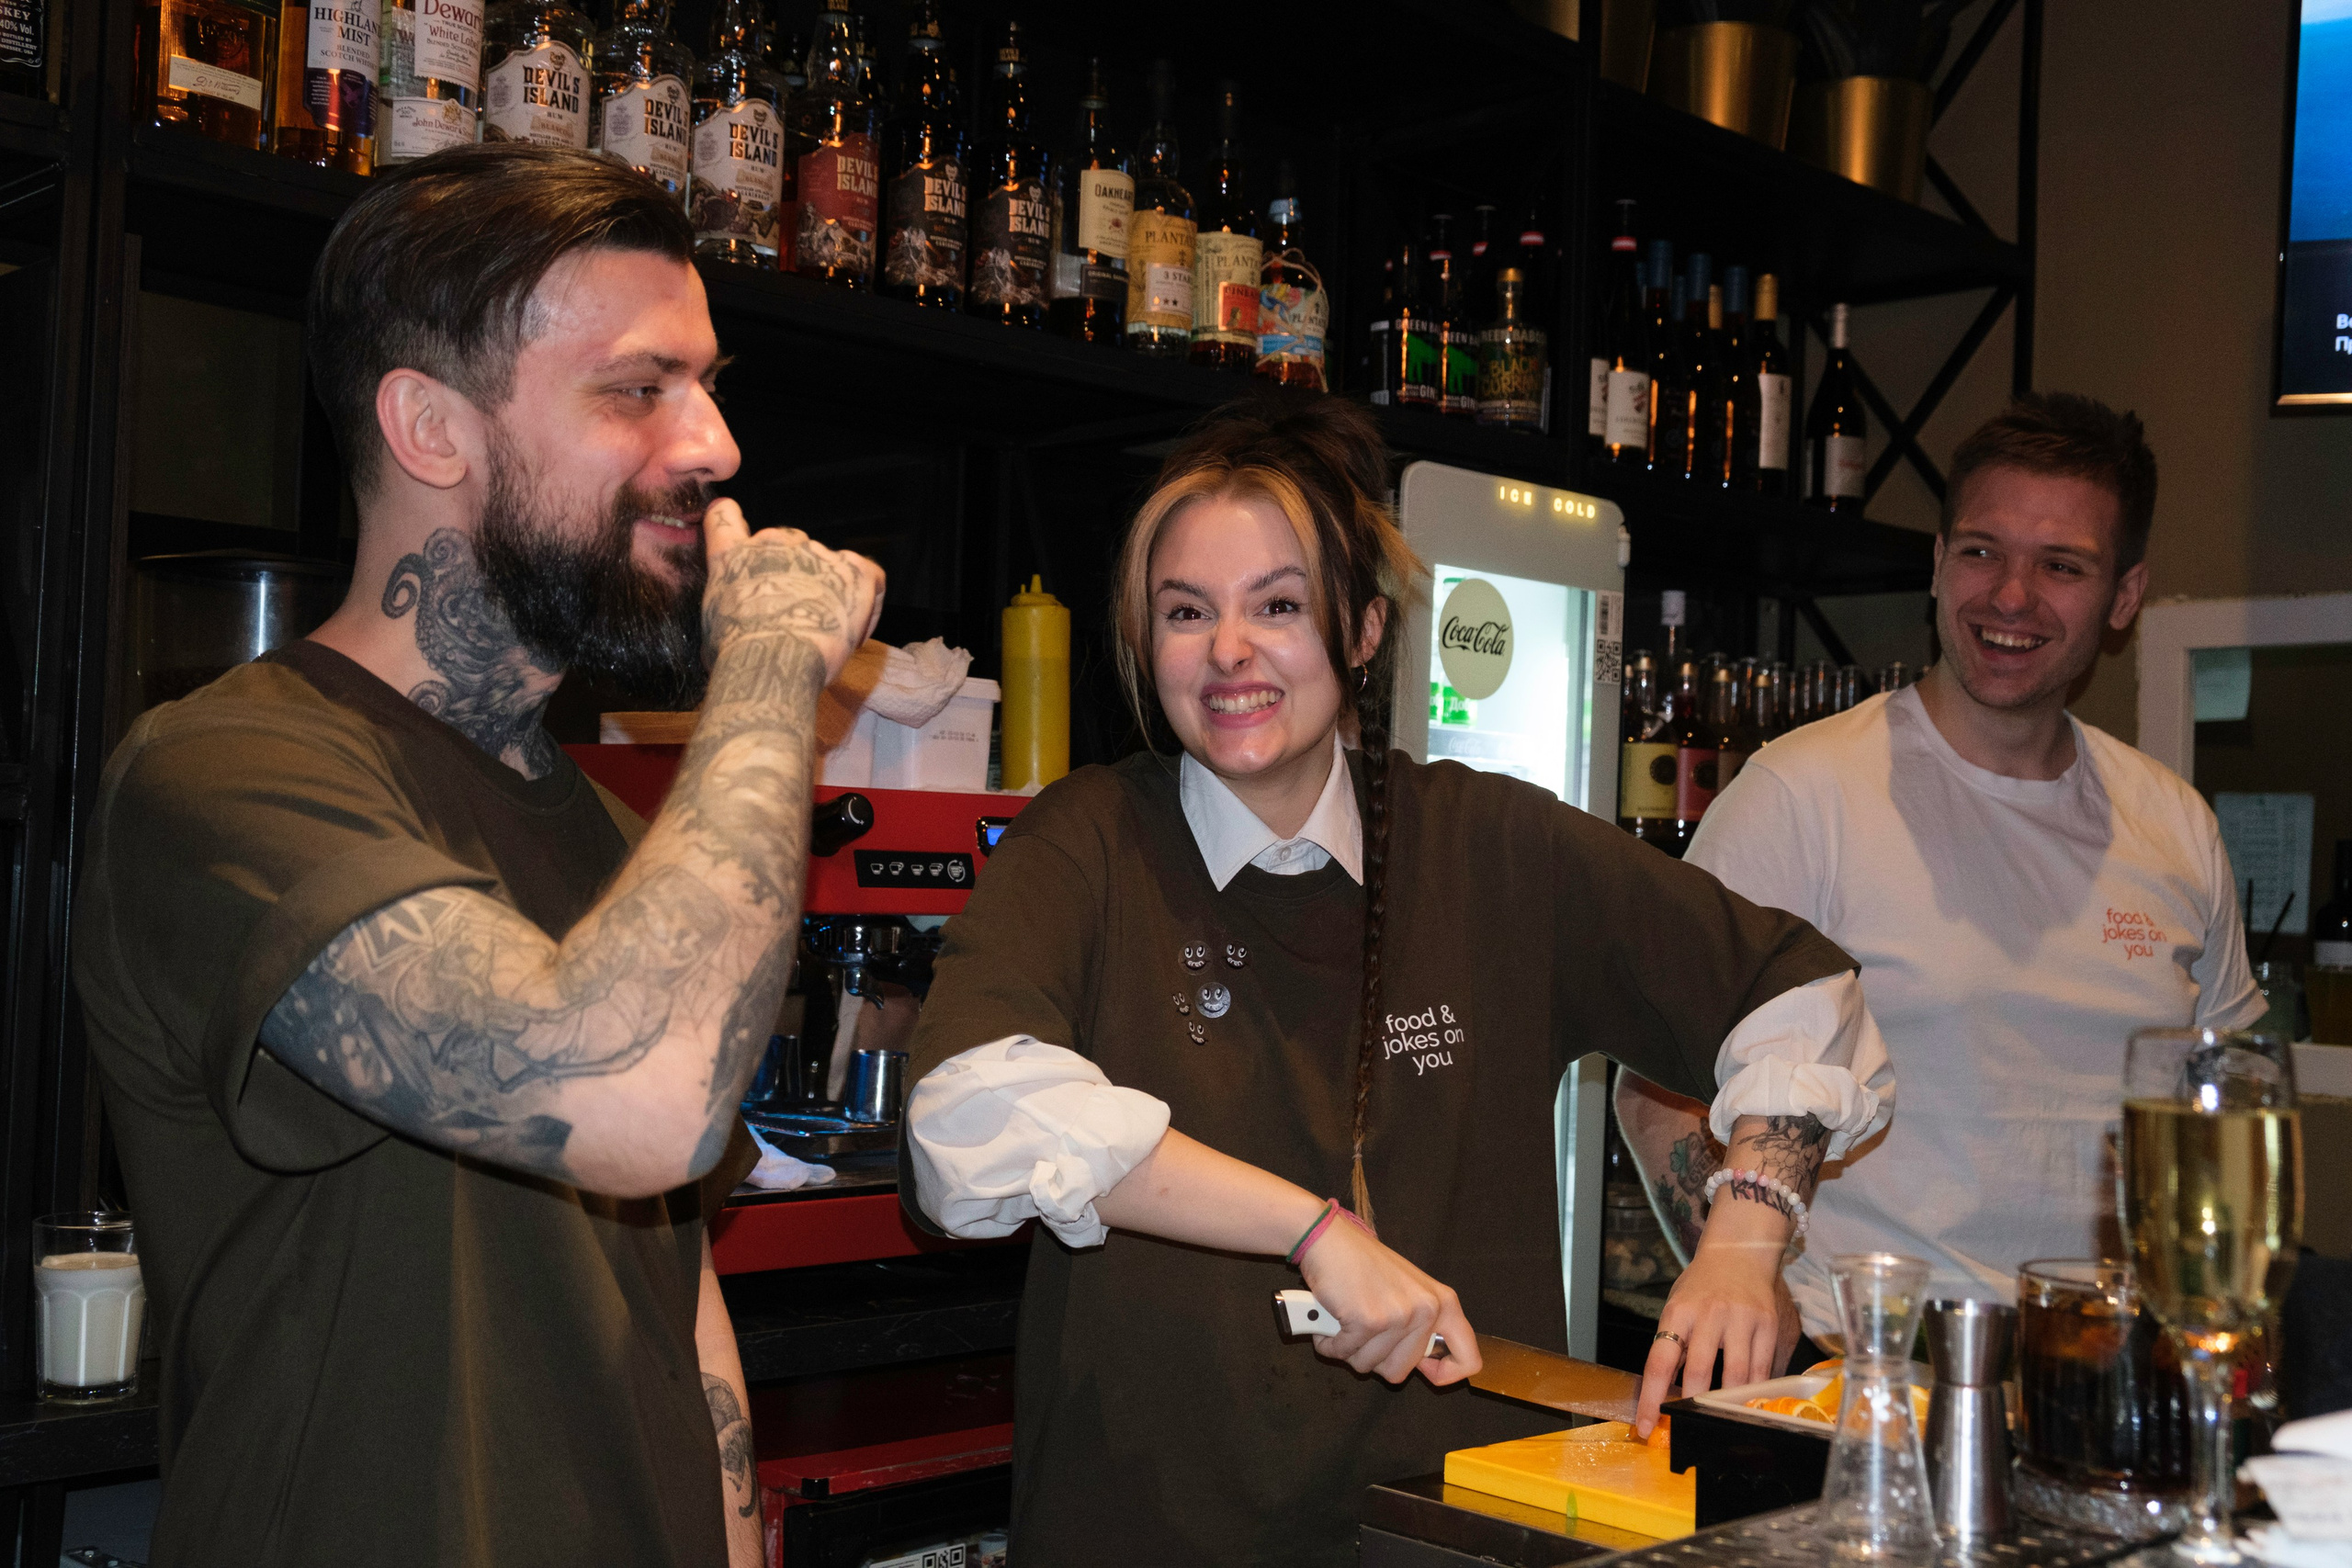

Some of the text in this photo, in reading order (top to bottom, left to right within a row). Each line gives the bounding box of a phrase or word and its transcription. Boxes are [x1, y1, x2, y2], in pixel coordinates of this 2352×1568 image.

[19, 23, 35, 36] Vol.
[441, 20, 456, 28] TRUE
[337, 26, 371, 47] MIST
[429, 26, 459, 42] White
[320, 49, 356, 63] SCOTCH
[336, 44, 370, 59] BLENDED
[522, 85, 580, 114] ISLAND
[412, 117, 434, 129] John
[547, 111, 563, 120] RUM
[729, 140, 777, 168] ISLAND
[1163, 271, 1170, 279] 3
[1419, 384, 1435, 400] GIN
[1460, 395, 1476, 410] GIN
[1499, 485, 1597, 519] ICE COLD
[1442, 615, 1510, 656] Coca-Cola
[2101, 923, 2167, 944] jokes on
[2123, 944, 2154, 961] you
[1385, 1004, 1457, 1034] food &
[1381, 1028, 1465, 1061] jokes on
[1411, 1051, 1453, 1077] you
